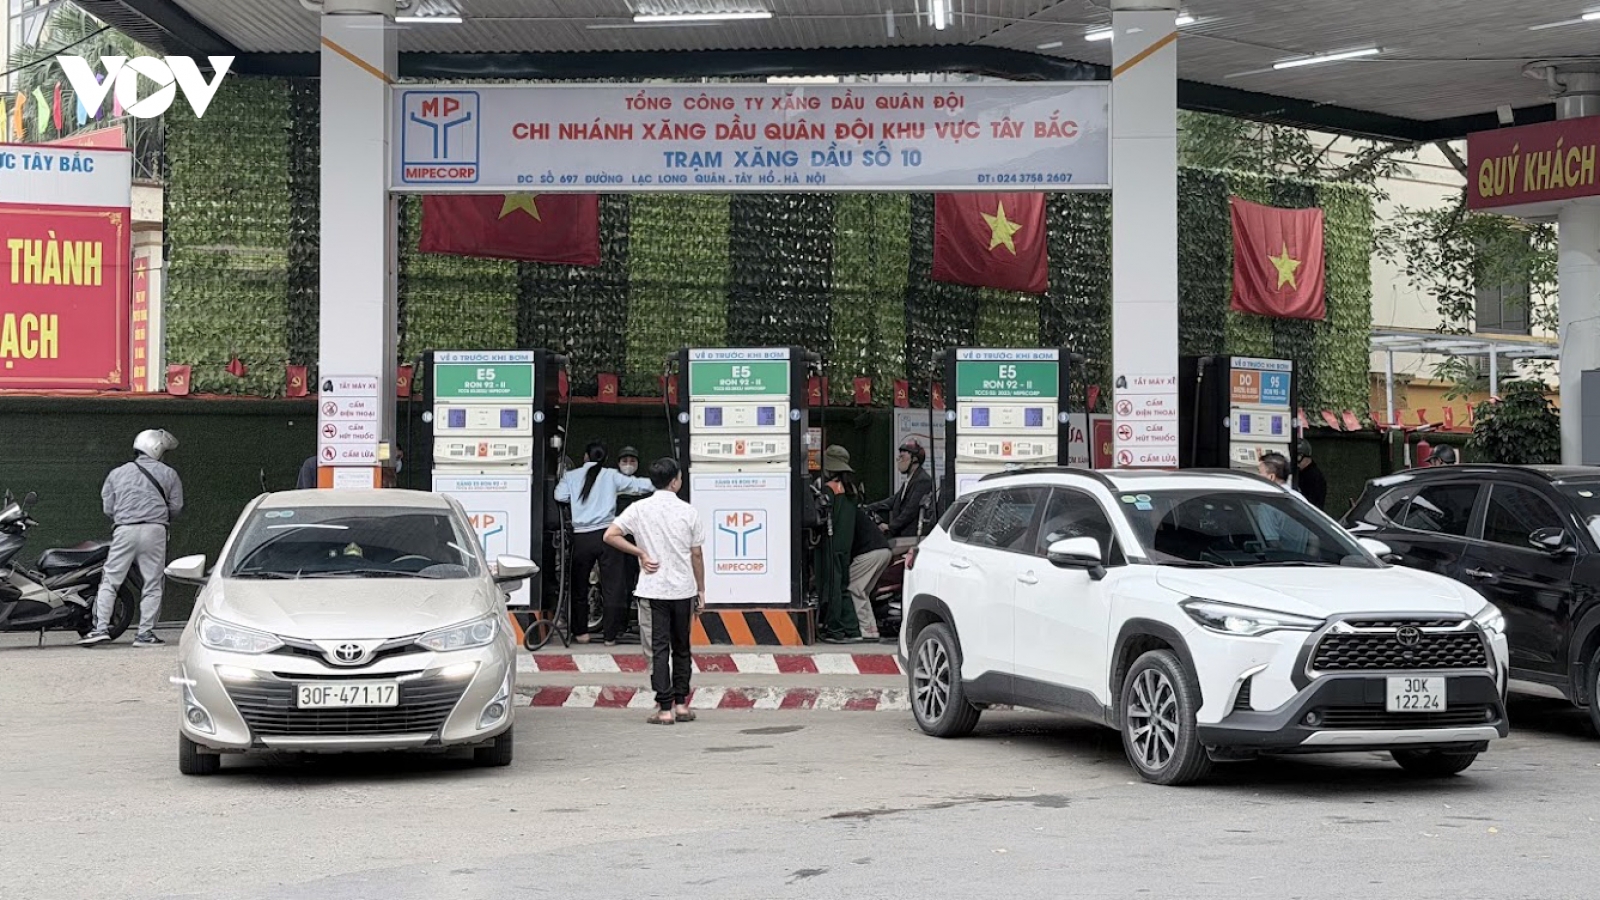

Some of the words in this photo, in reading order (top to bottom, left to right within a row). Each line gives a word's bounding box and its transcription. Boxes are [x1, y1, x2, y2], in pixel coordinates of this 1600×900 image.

[625, 90, 672, 110] TỔNG
[684, 93, 734, 110] CÔNG
[744, 97, 763, 110] TY
[772, 92, 820, 110] XĂNG
[832, 89, 864, 110] DẦU
[876, 92, 924, 110] QUÂN
[932, 92, 964, 112] ĐỘI
[512, 122, 549, 140] CHI
[558, 118, 633, 140] NHÁNH
[642, 119, 706, 140] XĂNG
[715, 114, 756, 140] DẦU
[764, 118, 825, 140] QUÂN
[835, 118, 874, 144] ĐỘI
[882, 122, 925, 140] KHU
[935, 120, 980, 144] VỰC
[990, 117, 1024, 139] TÂY
[1034, 110, 1078, 139] BẮC
[22, 152, 54, 170] TÂY
[59, 151, 94, 172] BẮC
[664, 151, 722, 172] TRẠM
[734, 146, 798, 168] XĂNG
[810, 141, 852, 168] DẦU
[862, 140, 891, 167] SỐ
[900, 150, 922, 166] 10
[406, 168, 475, 179] MIPECORP
[1478, 142, 1520, 197] QUÝ
[1523, 136, 1596, 192] KHÁCH
[540, 170, 554, 184] SỐ
[560, 174, 578, 184] 697
[585, 170, 623, 184] ĐƯỜNG
[632, 174, 652, 186] LẠC
[658, 174, 687, 184] LONG
[694, 172, 726, 184] QUÂN
[735, 171, 752, 184] TÂY
[759, 170, 775, 184] HỒ
[784, 170, 798, 184] HÀ
[806, 171, 825, 184] NỘI
[997, 174, 1016, 182] 024
[1019, 174, 1043, 182] 3758
[1046, 174, 1072, 182] 2607
[7, 230, 102, 286] THÀNH
[0, 313, 58, 368] ẠCH
[476, 368, 496, 380] E5
[732, 366, 750, 378] E5
[999, 365, 1016, 378] E5
[1006, 380, 1018, 389] 92
[1240, 374, 1252, 386] DO
[1270, 376, 1280, 388] 95
[1140, 454, 1159, 462] CẤM
[1405, 679, 1428, 693] 30K
[302, 686, 394, 705] 30F-471.17
[1395, 695, 1439, 709] 122.24
